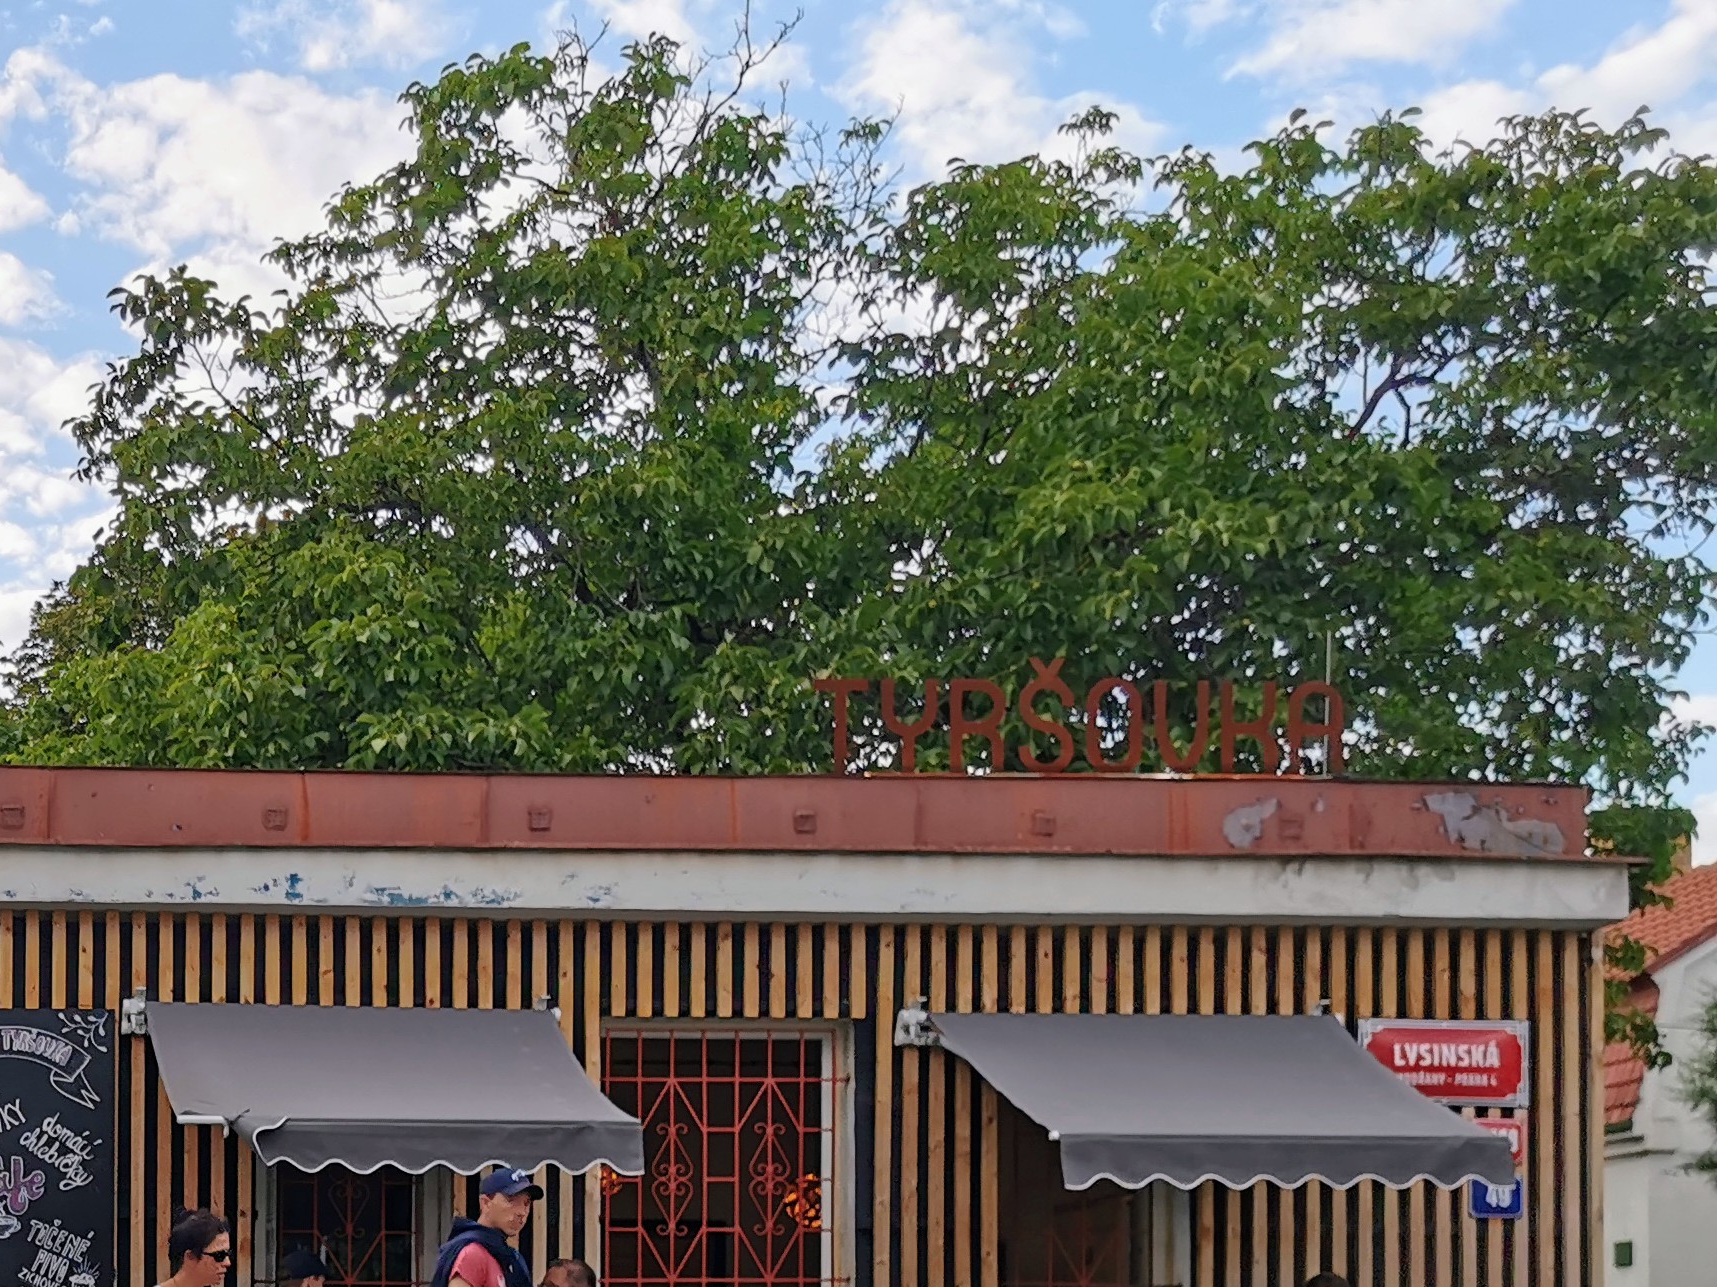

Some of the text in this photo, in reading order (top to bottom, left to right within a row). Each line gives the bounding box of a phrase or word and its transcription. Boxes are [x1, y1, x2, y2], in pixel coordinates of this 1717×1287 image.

[815, 657, 1346, 772] TYRŠOVKA
[42, 1112, 103, 1160] domácí
[27, 1219, 95, 1263] TOČENÉ
[31, 1249, 69, 1284] PIVO
